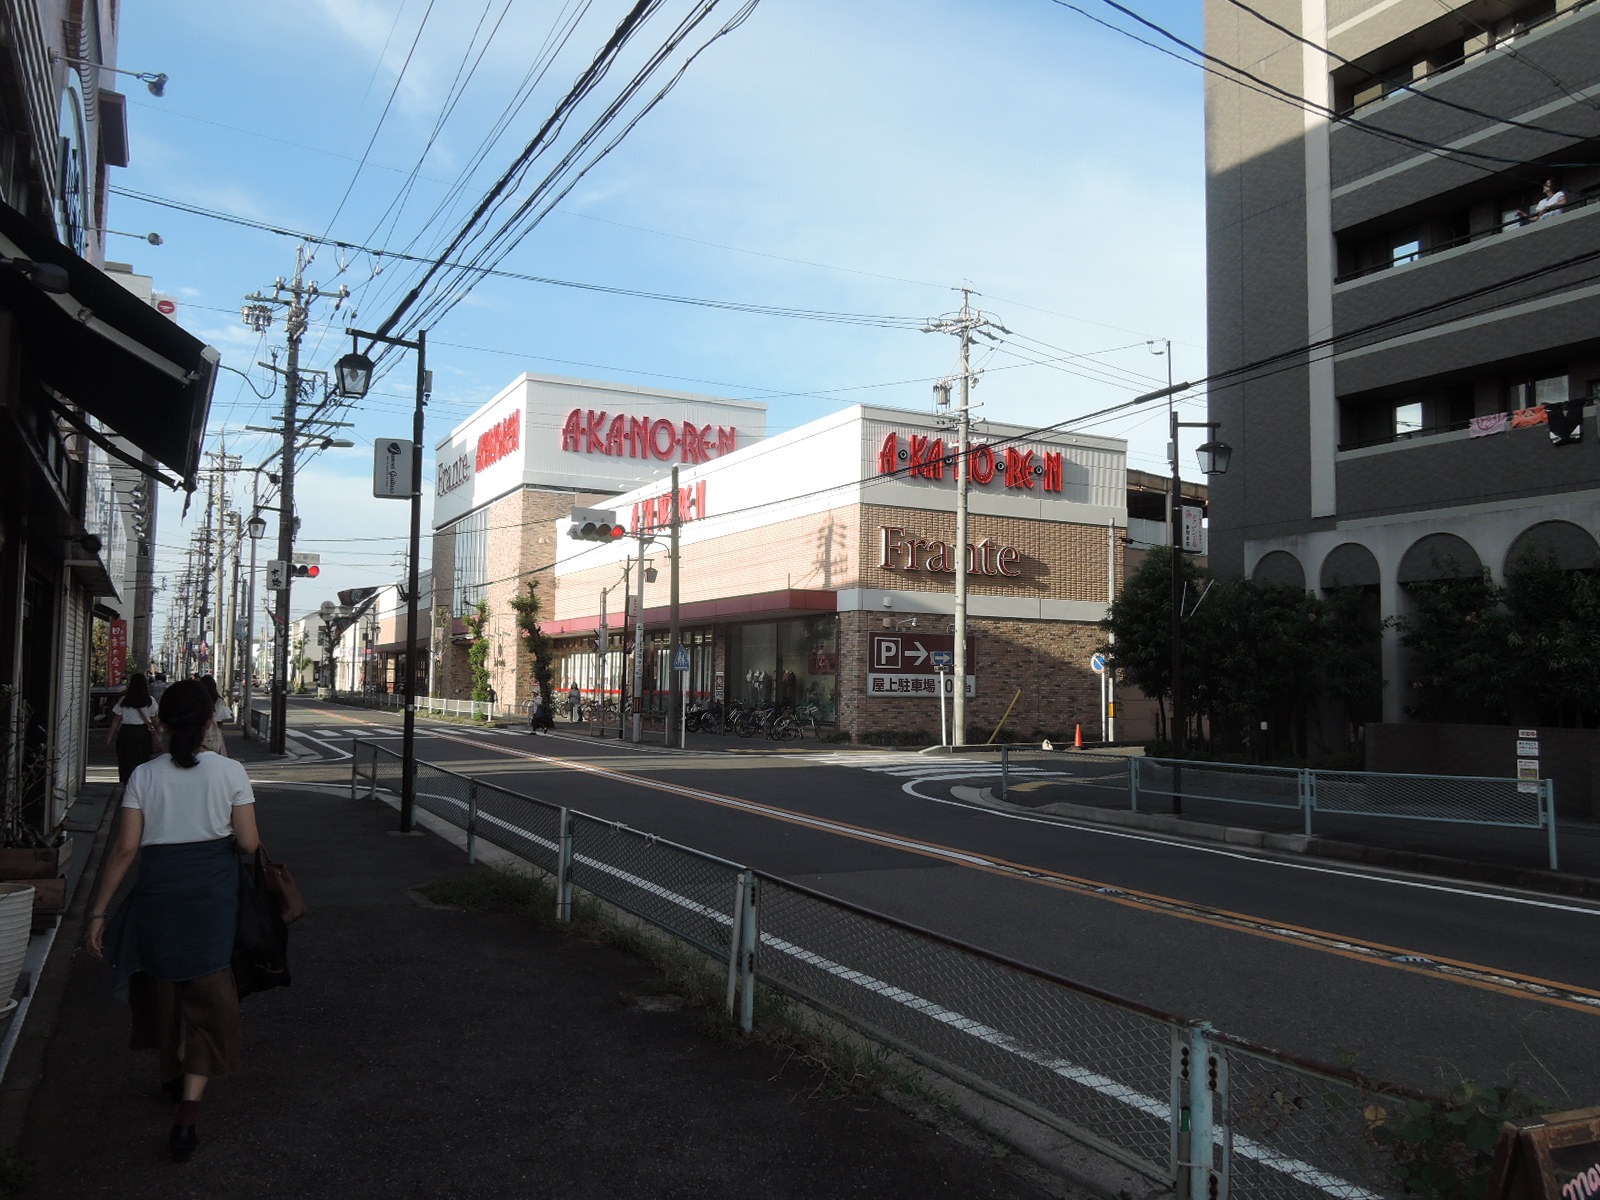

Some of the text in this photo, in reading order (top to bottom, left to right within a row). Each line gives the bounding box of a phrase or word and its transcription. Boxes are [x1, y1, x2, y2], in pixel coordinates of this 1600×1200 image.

[437, 454, 470, 497] Frante
[877, 525, 1021, 577] Frante
[881, 641, 897, 665] P
